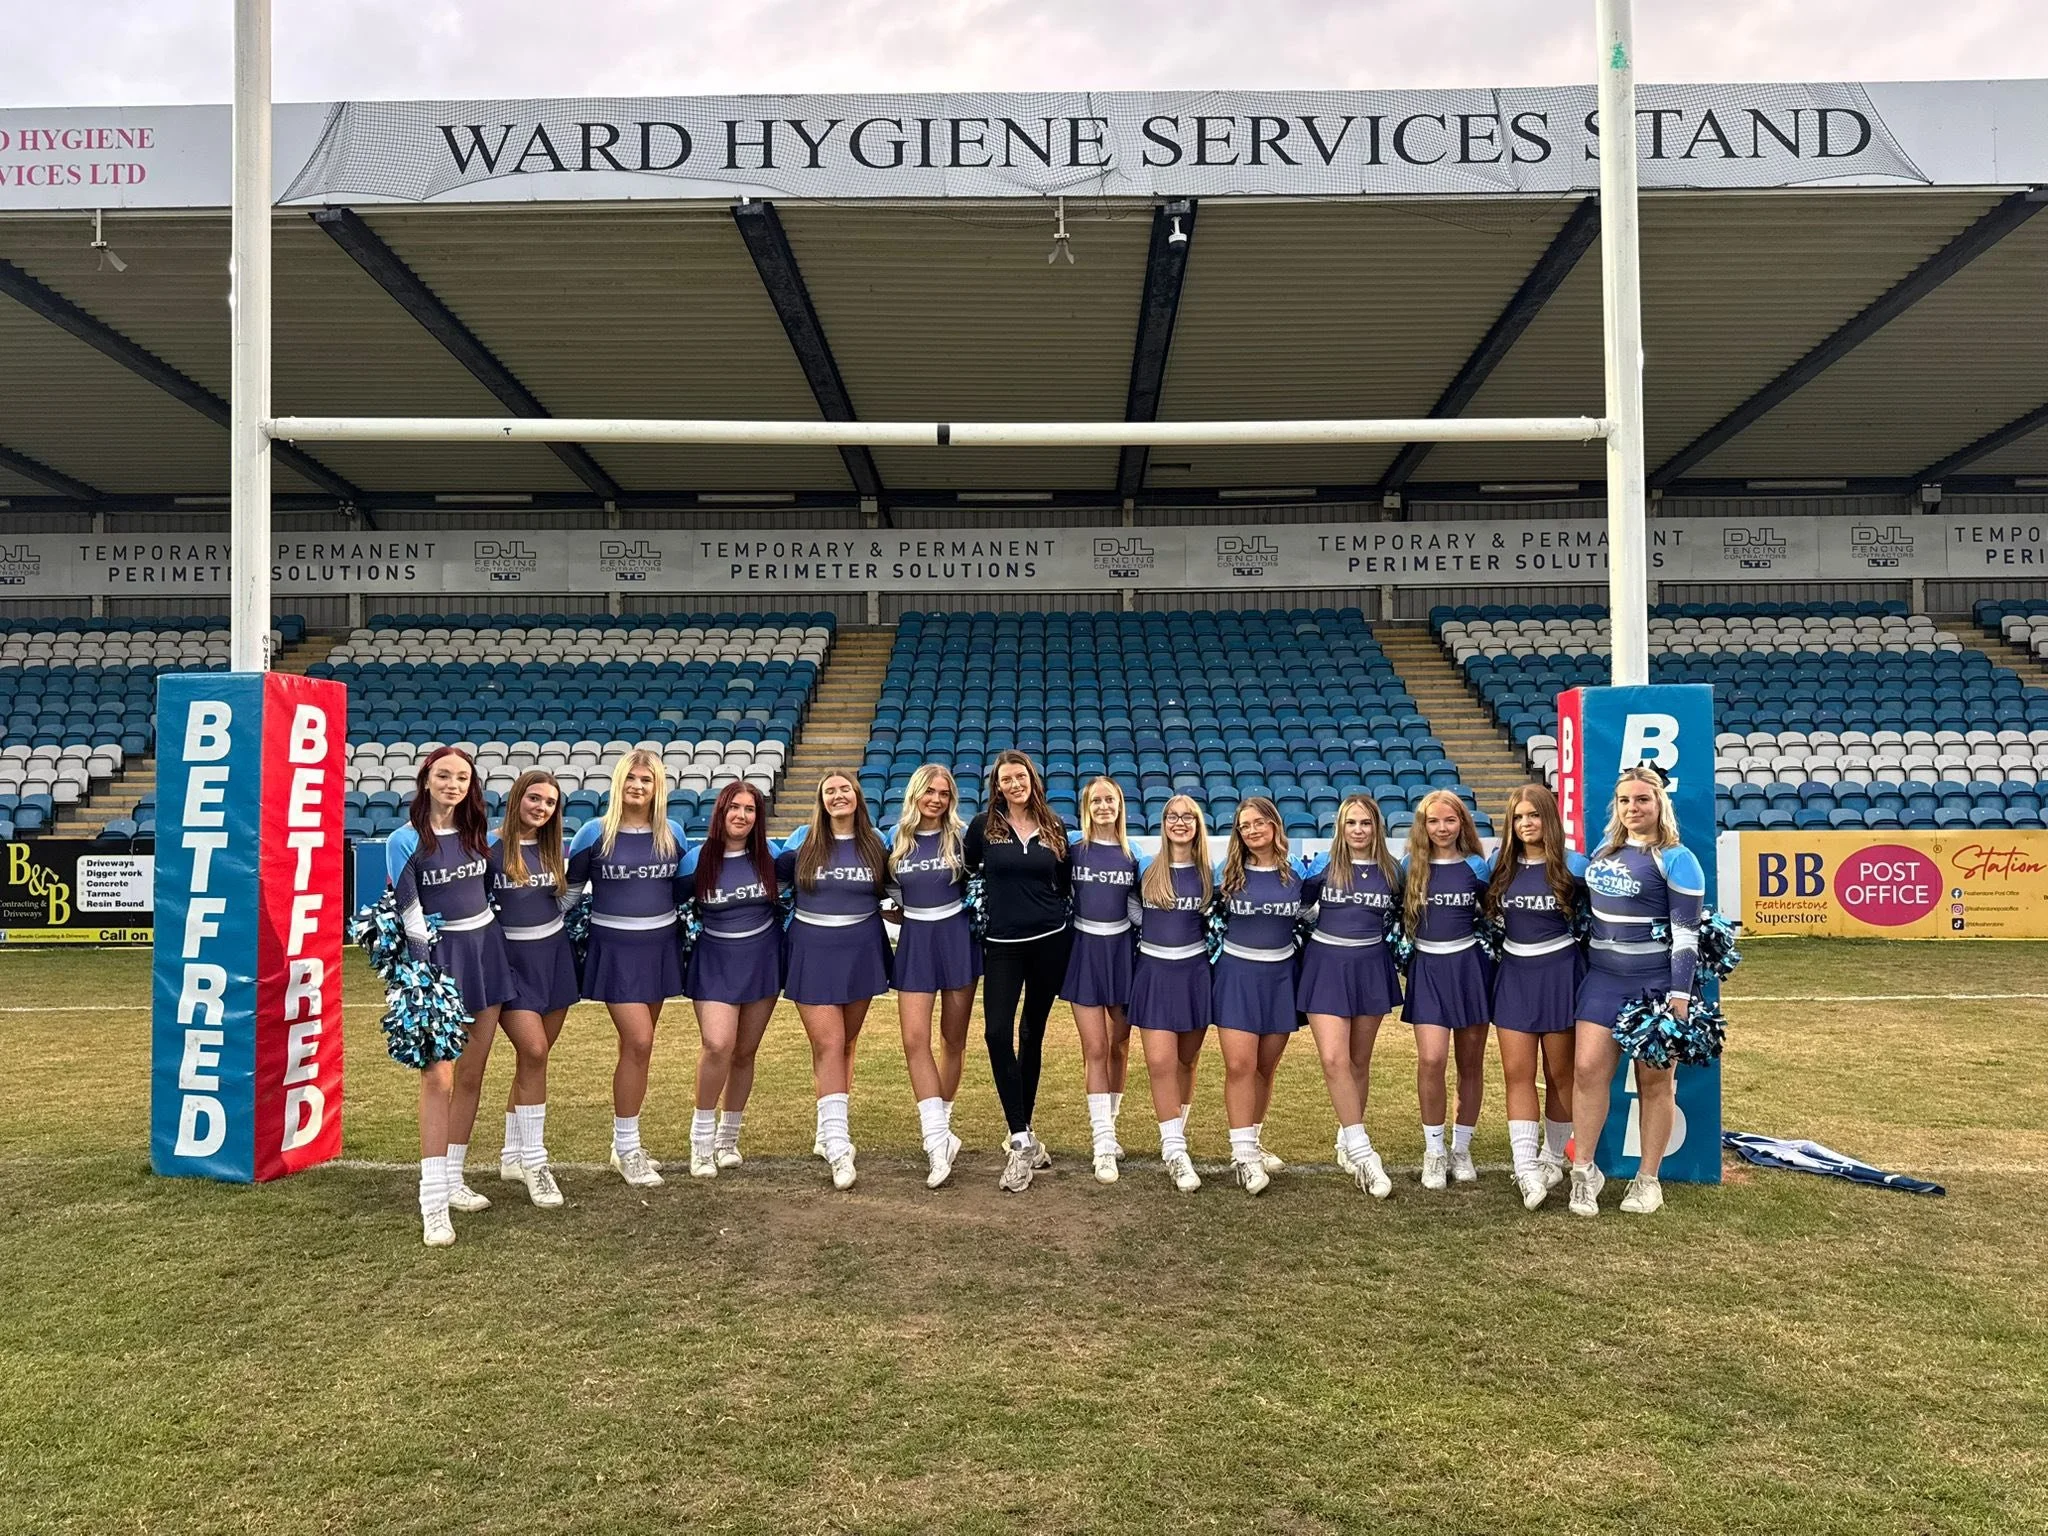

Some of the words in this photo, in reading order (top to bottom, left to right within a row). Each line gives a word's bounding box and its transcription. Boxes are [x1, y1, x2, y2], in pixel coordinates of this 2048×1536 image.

[18, 128, 155, 151] HYGIENE
[436, 121, 692, 175] WARD
[720, 118, 1112, 168] HYGIENE
[1142, 112, 1552, 167] SERVICES
[89, 163, 146, 185] LTD
[1318, 533, 1476, 551] TEMPORARY
[1491, 532, 1505, 548] &
[1522, 530, 1684, 548] PERMANT
[1723, 528, 1786, 546] DJL
[1851, 526, 1913, 545] DJL
[1954, 526, 2041, 543] TEMPO
[0, 545, 40, 562] JL
[278, 543, 436, 560] PERMANENT
[474, 540, 537, 559] DJL
[600, 540, 661, 559] DJL
[700, 542, 855, 558] TEMPORARY
[870, 541, 883, 557] &
[899, 540, 1055, 557] PERMANENT
[1093, 538, 1154, 556] DJL
[1217, 536, 1278, 554] DJL
[1851, 545, 1913, 553] FENCING
[474, 559, 537, 567] FENCING
[600, 559, 661, 567] FENCING
[1093, 556, 1154, 564] FENCING
[1217, 554, 1278, 562] FENCING
[1349, 554, 1501, 572] PERIMETER
[1515, 552, 1664, 570] SOLUTIS
[1740, 560, 1771, 568] LTD
[1868, 558, 1899, 567] LTD
[1986, 548, 2044, 564] PERI
[108, 566, 231, 582] PERIMET
[271, 564, 416, 581] SOLUTIONS
[490, 572, 520, 581] LTD
[616, 572, 646, 581] LTD
[731, 563, 878, 579] PERIMETER
[893, 562, 1036, 578] SOLUTIONS
[1109, 569, 1139, 578] LTD
[1233, 567, 1263, 576] LTD
[86, 860, 135, 868] Driveways
[1951, 844, 2047, 881] Station
[86, 870, 117, 879] Digger
[1758, 852, 1826, 898] BB
[1859, 862, 1921, 881] POST
[1845, 884, 1930, 905] OFFICE
[1755, 899, 1828, 910] Featherstone
[3, 910, 42, 918] Driveways
[1755, 911, 1828, 926] Superstore
[99, 930, 126, 941] Call
[130, 932, 148, 941] on
[174, 700, 232, 1157] BETFRED
[281, 703, 329, 1152] BETFRED
